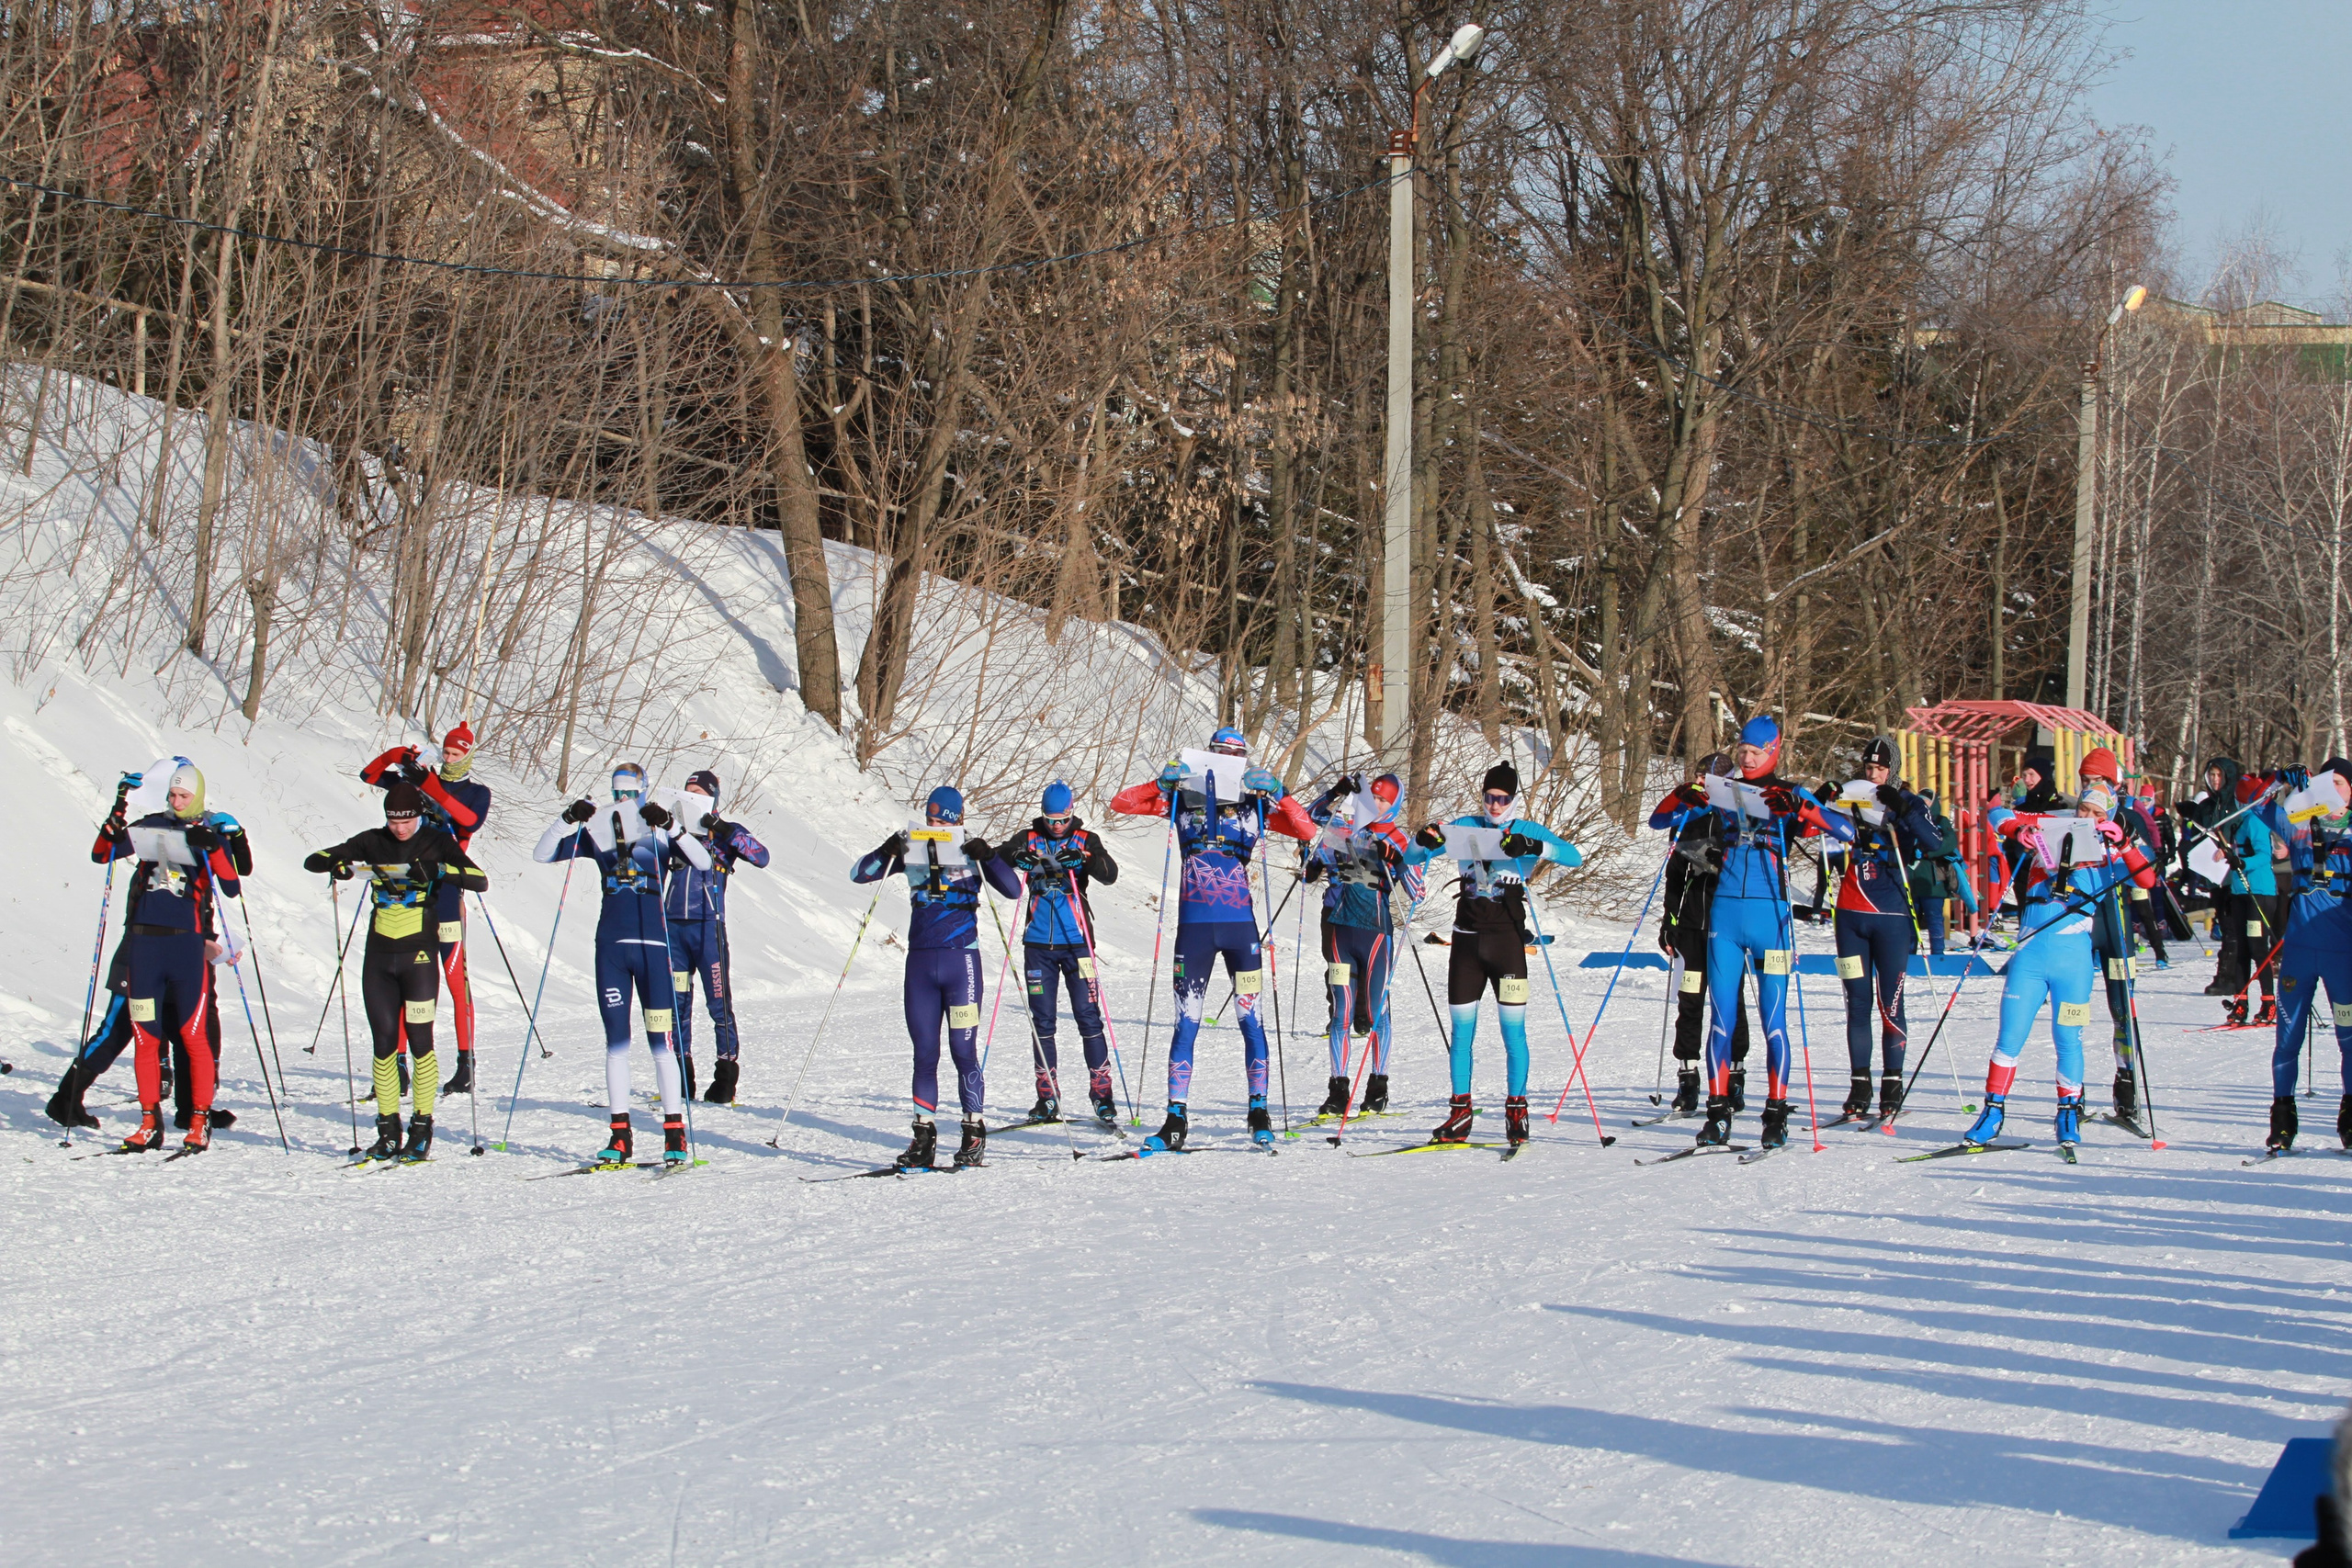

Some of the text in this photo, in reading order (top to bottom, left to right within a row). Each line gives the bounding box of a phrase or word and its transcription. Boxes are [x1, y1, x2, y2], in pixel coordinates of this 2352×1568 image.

[2035, 835, 2052, 864] MAGNETO
[711, 961, 724, 998] RUSSIA
[965, 953, 975, 1006] НИЖЕГОРОДСКА
